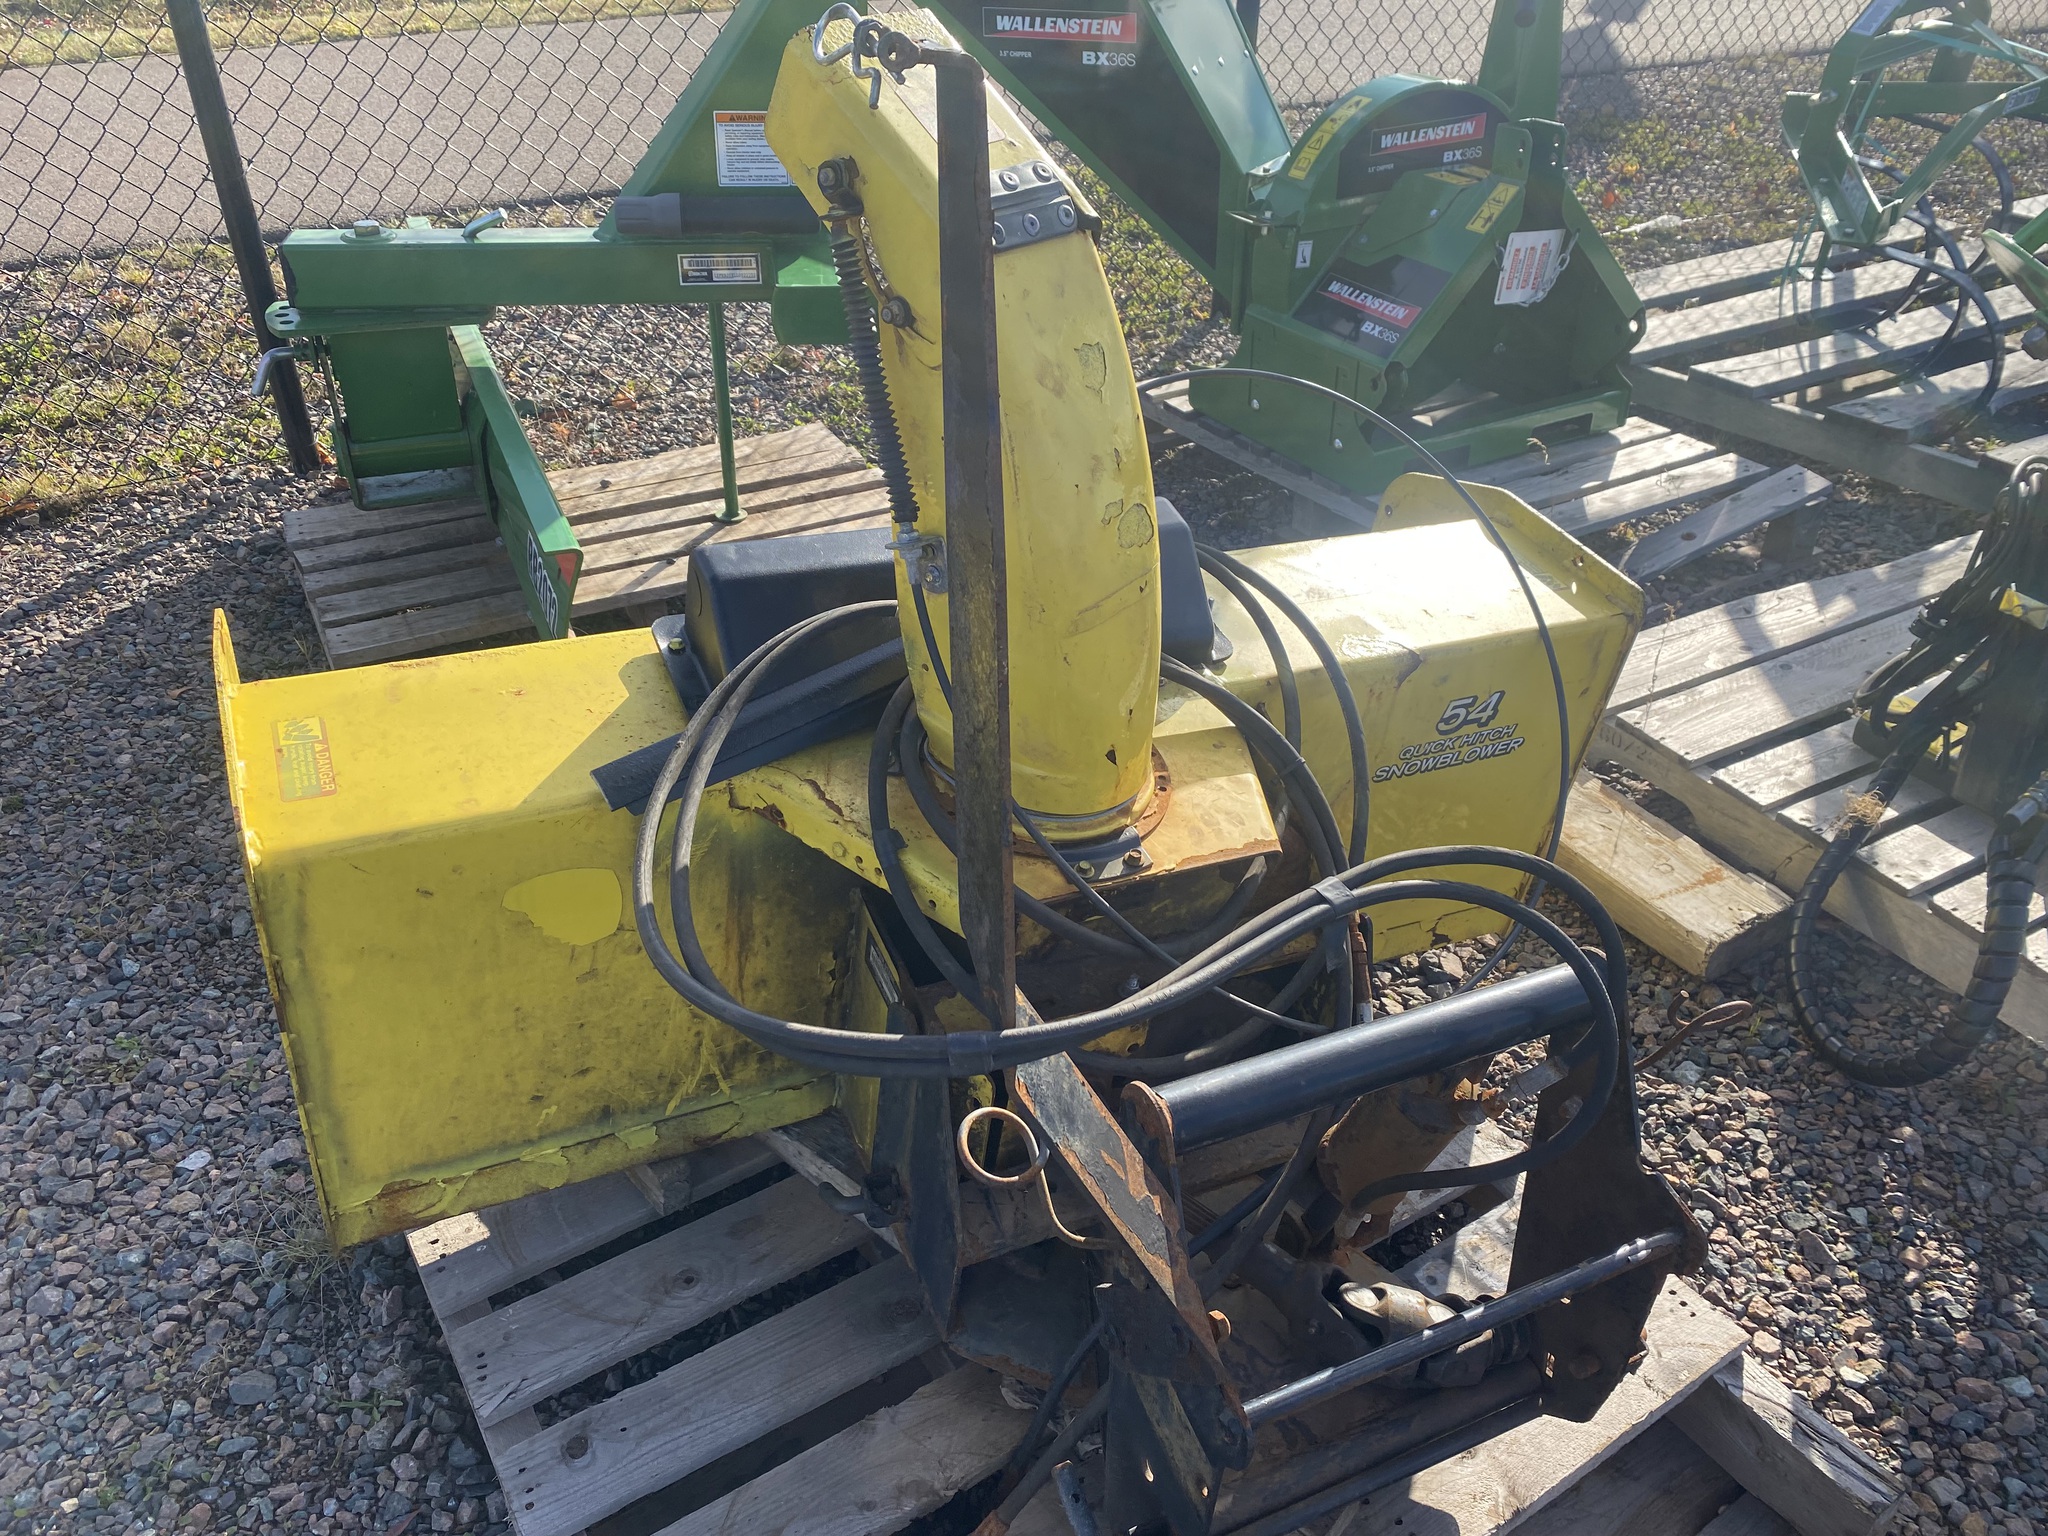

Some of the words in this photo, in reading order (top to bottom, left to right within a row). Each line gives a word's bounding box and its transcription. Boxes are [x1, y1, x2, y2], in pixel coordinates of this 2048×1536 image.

[996, 15, 1122, 36] WALLENSTEIN
[1082, 51, 1136, 67] BX36S
[736, 114, 765, 122] WARNIN
[1380, 121, 1476, 149] WALLENSTEIN
[1443, 146, 1483, 162] BX36S
[1327, 280, 1409, 320] WALLENSTEIN
[1360, 320, 1400, 344] BX36S
[1436, 690, 1505, 735] 54
[1399, 735, 1461, 760] QUICK
[1459, 723, 1518, 748] HITCH
[315, 752, 335, 792] DANGER
[1372, 737, 1525, 783] SNOWBLOWER
